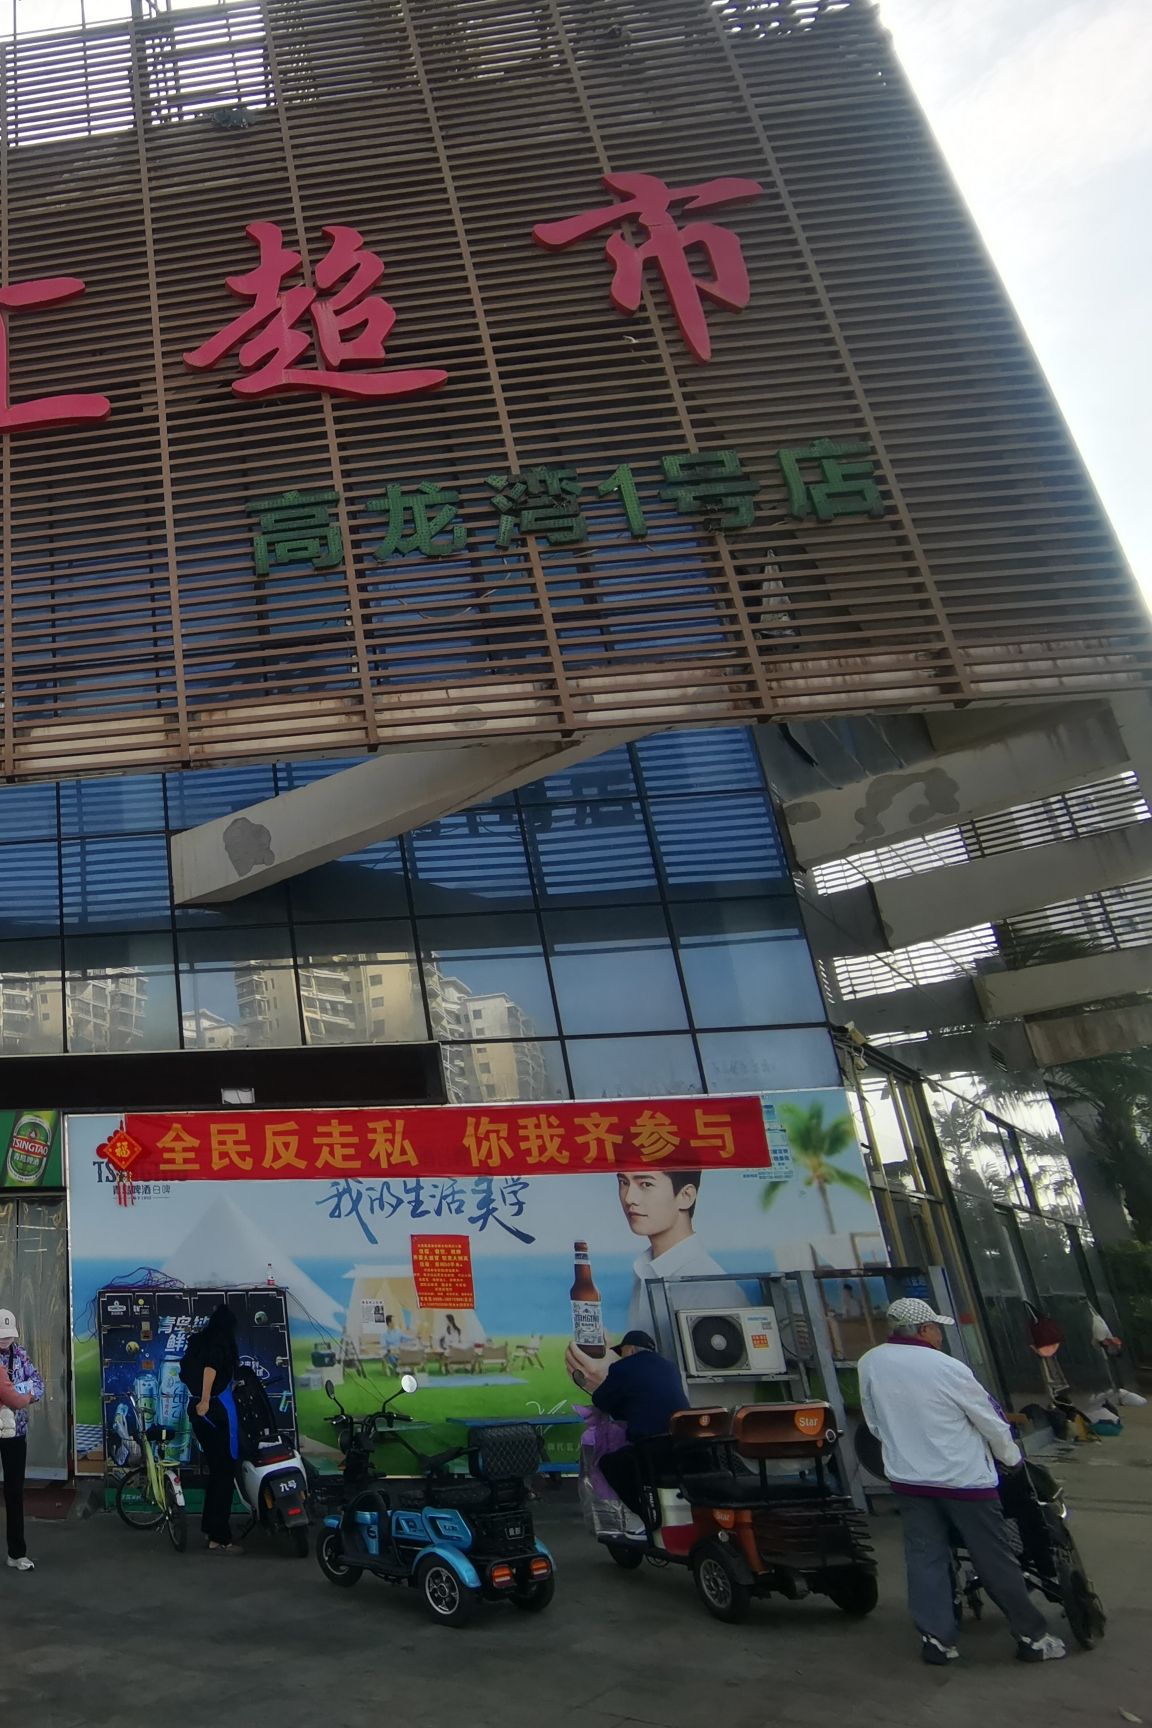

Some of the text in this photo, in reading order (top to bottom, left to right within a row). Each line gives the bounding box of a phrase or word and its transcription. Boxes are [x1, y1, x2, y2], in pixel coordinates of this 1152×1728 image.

[244, 437, 886, 577] 高龙湾1号店
[11, 1138, 48, 1156] TSINGTAO
[156, 1108, 735, 1171] 全民反走私 你我齐参与
[315, 1176, 535, 1245] 我的生活美学
[799, 1416, 818, 1428] Star
[280, 1480, 297, 1492] 九号
